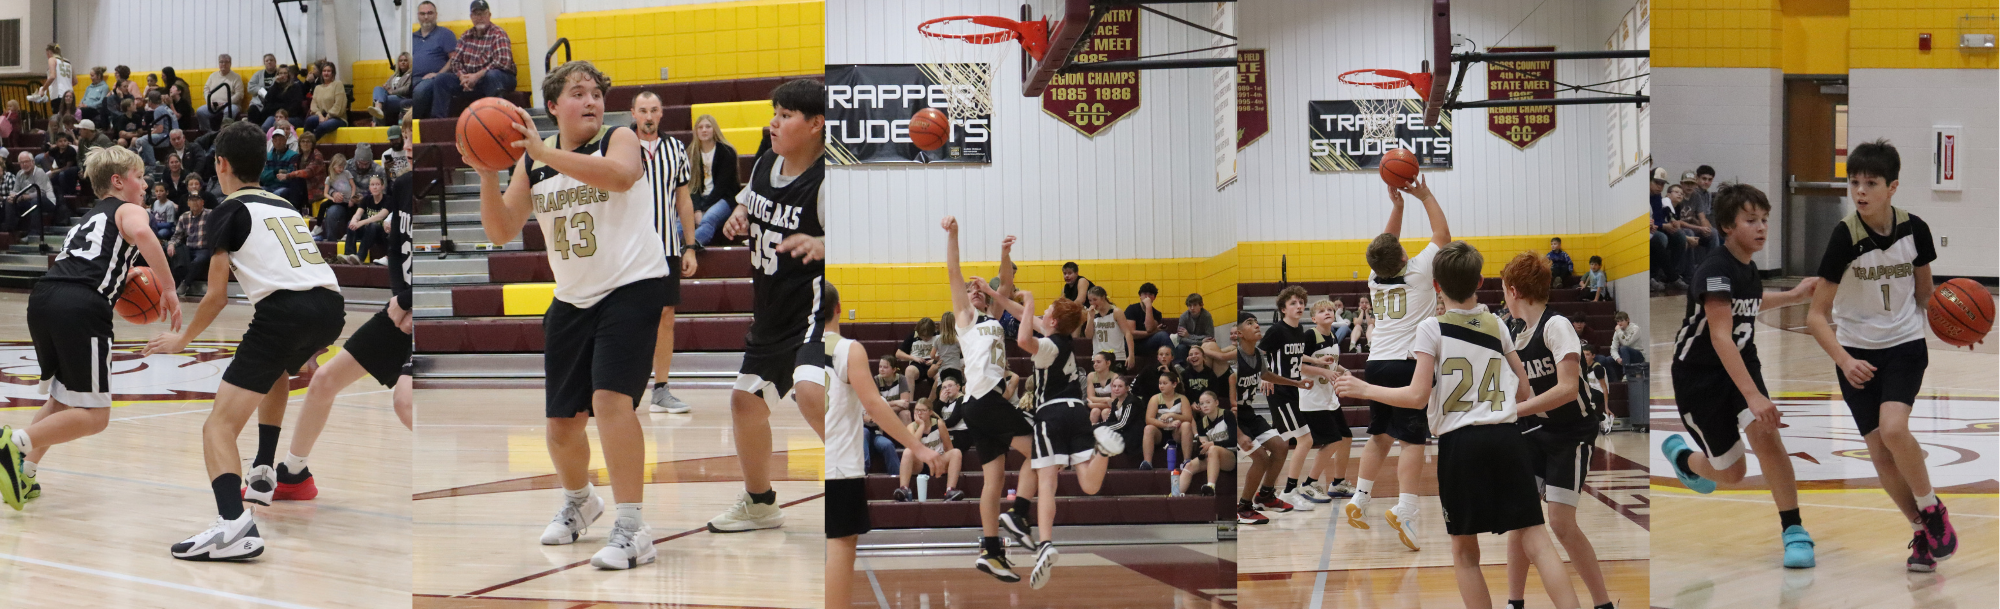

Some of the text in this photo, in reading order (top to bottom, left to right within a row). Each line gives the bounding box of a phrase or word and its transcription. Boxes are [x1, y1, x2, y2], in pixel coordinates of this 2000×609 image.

[1094, 25, 1120, 36] ACE
[1094, 38, 1133, 51] MEET
[1244, 52, 1260, 62] FIELD
[1516, 60, 1551, 70] COUNTRY
[1087, 71, 1136, 85] CHAMPS
[1499, 71, 1514, 80] 4th
[1490, 80, 1550, 91] STATE MEET
[825, 84, 977, 109] RAPPER
[1050, 87, 1132, 101] 1985 1986
[1489, 104, 1553, 114] REGION CHAMPS
[1493, 114, 1551, 125] 1985 1986
[1312, 137, 1451, 156] STUDENTS
[533, 184, 610, 213] TRAPPERS
[747, 190, 803, 230] OUGARS
[263, 216, 326, 269] 15
[554, 211, 597, 260] 43
[749, 222, 783, 276] 35
[1852, 262, 1914, 281] TRAPPER
[1373, 287, 1407, 321] 40
[1881, 283, 1892, 312] 1
[1096, 329, 1108, 343] 31
[1441, 356, 1506, 416] 24
